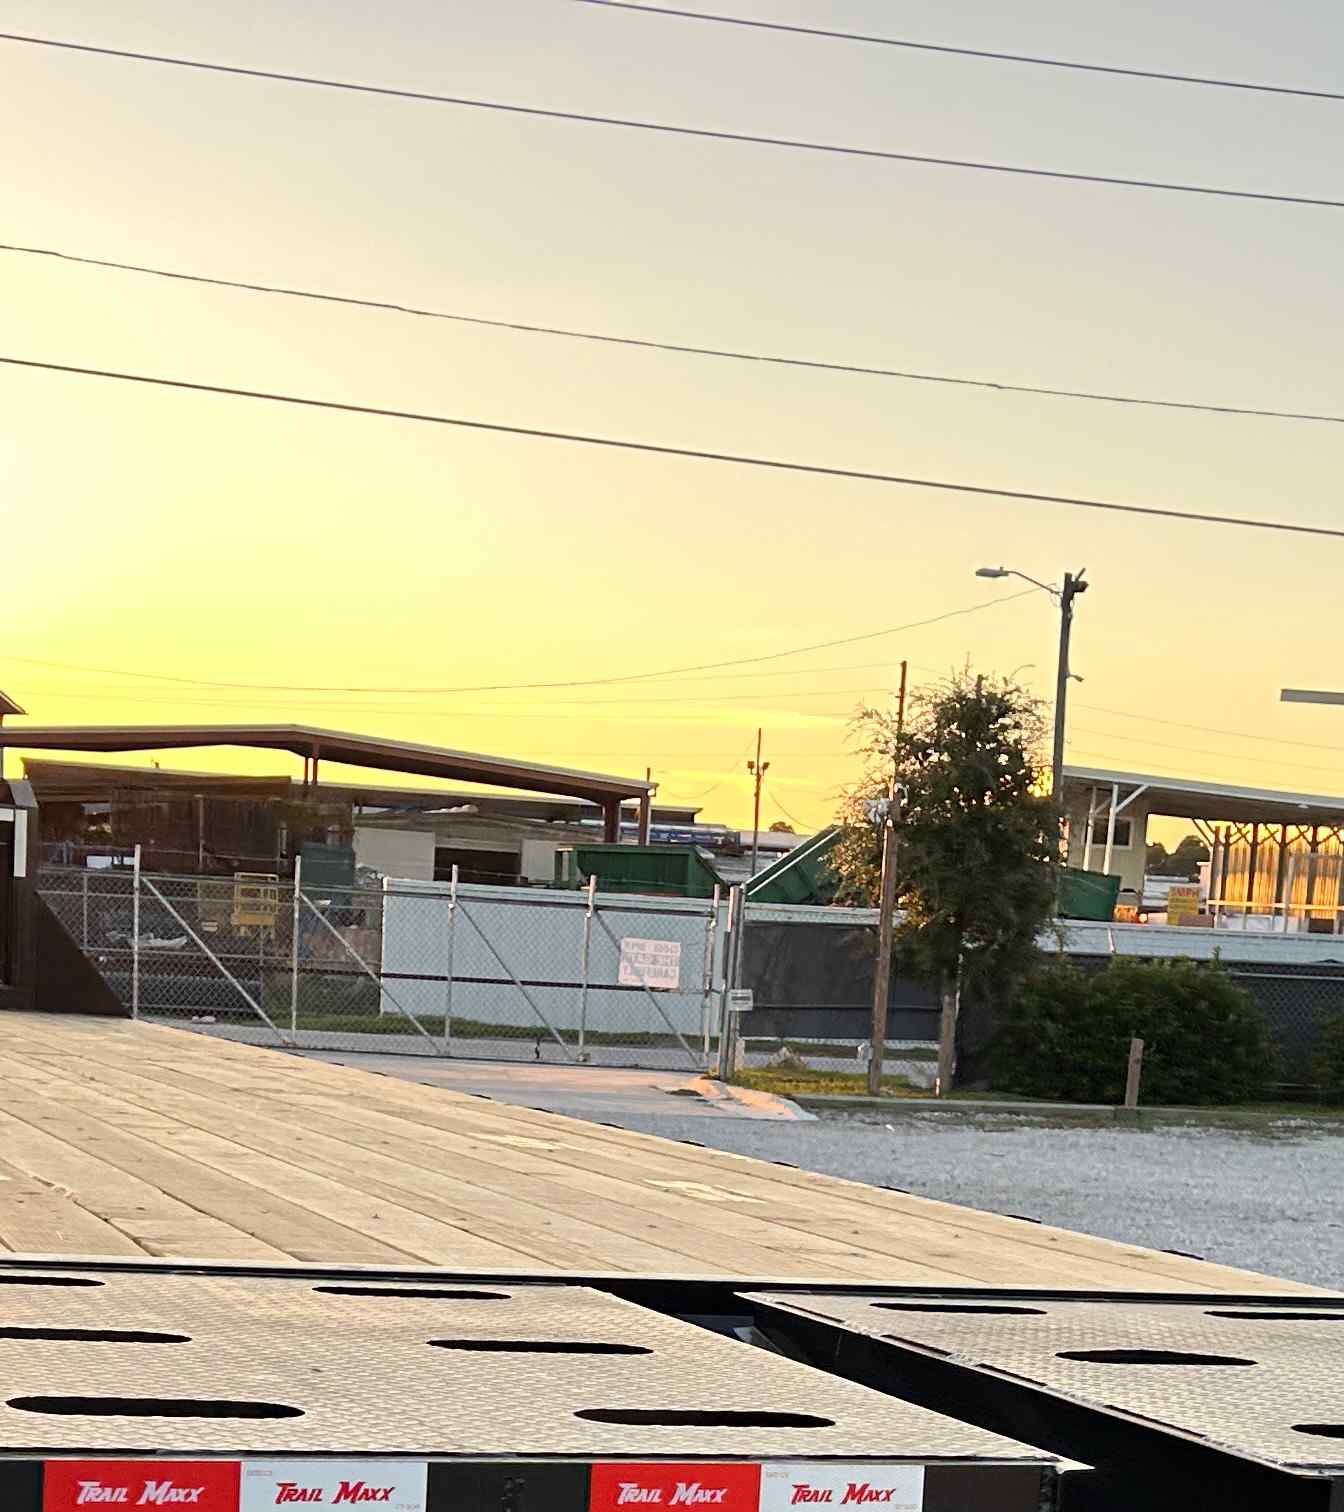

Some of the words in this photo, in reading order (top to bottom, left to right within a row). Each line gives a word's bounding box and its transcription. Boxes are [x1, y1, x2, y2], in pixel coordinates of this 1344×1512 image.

[76, 1481, 128, 1505] TRAIL
[135, 1480, 205, 1506] MAXX
[274, 1481, 323, 1505] TRAIL
[331, 1480, 396, 1505] MAXX
[617, 1482, 662, 1505] TRAIL
[668, 1482, 728, 1506] MAXX
[790, 1482, 834, 1505] TRAIL
[840, 1482, 896, 1505] MAXX
